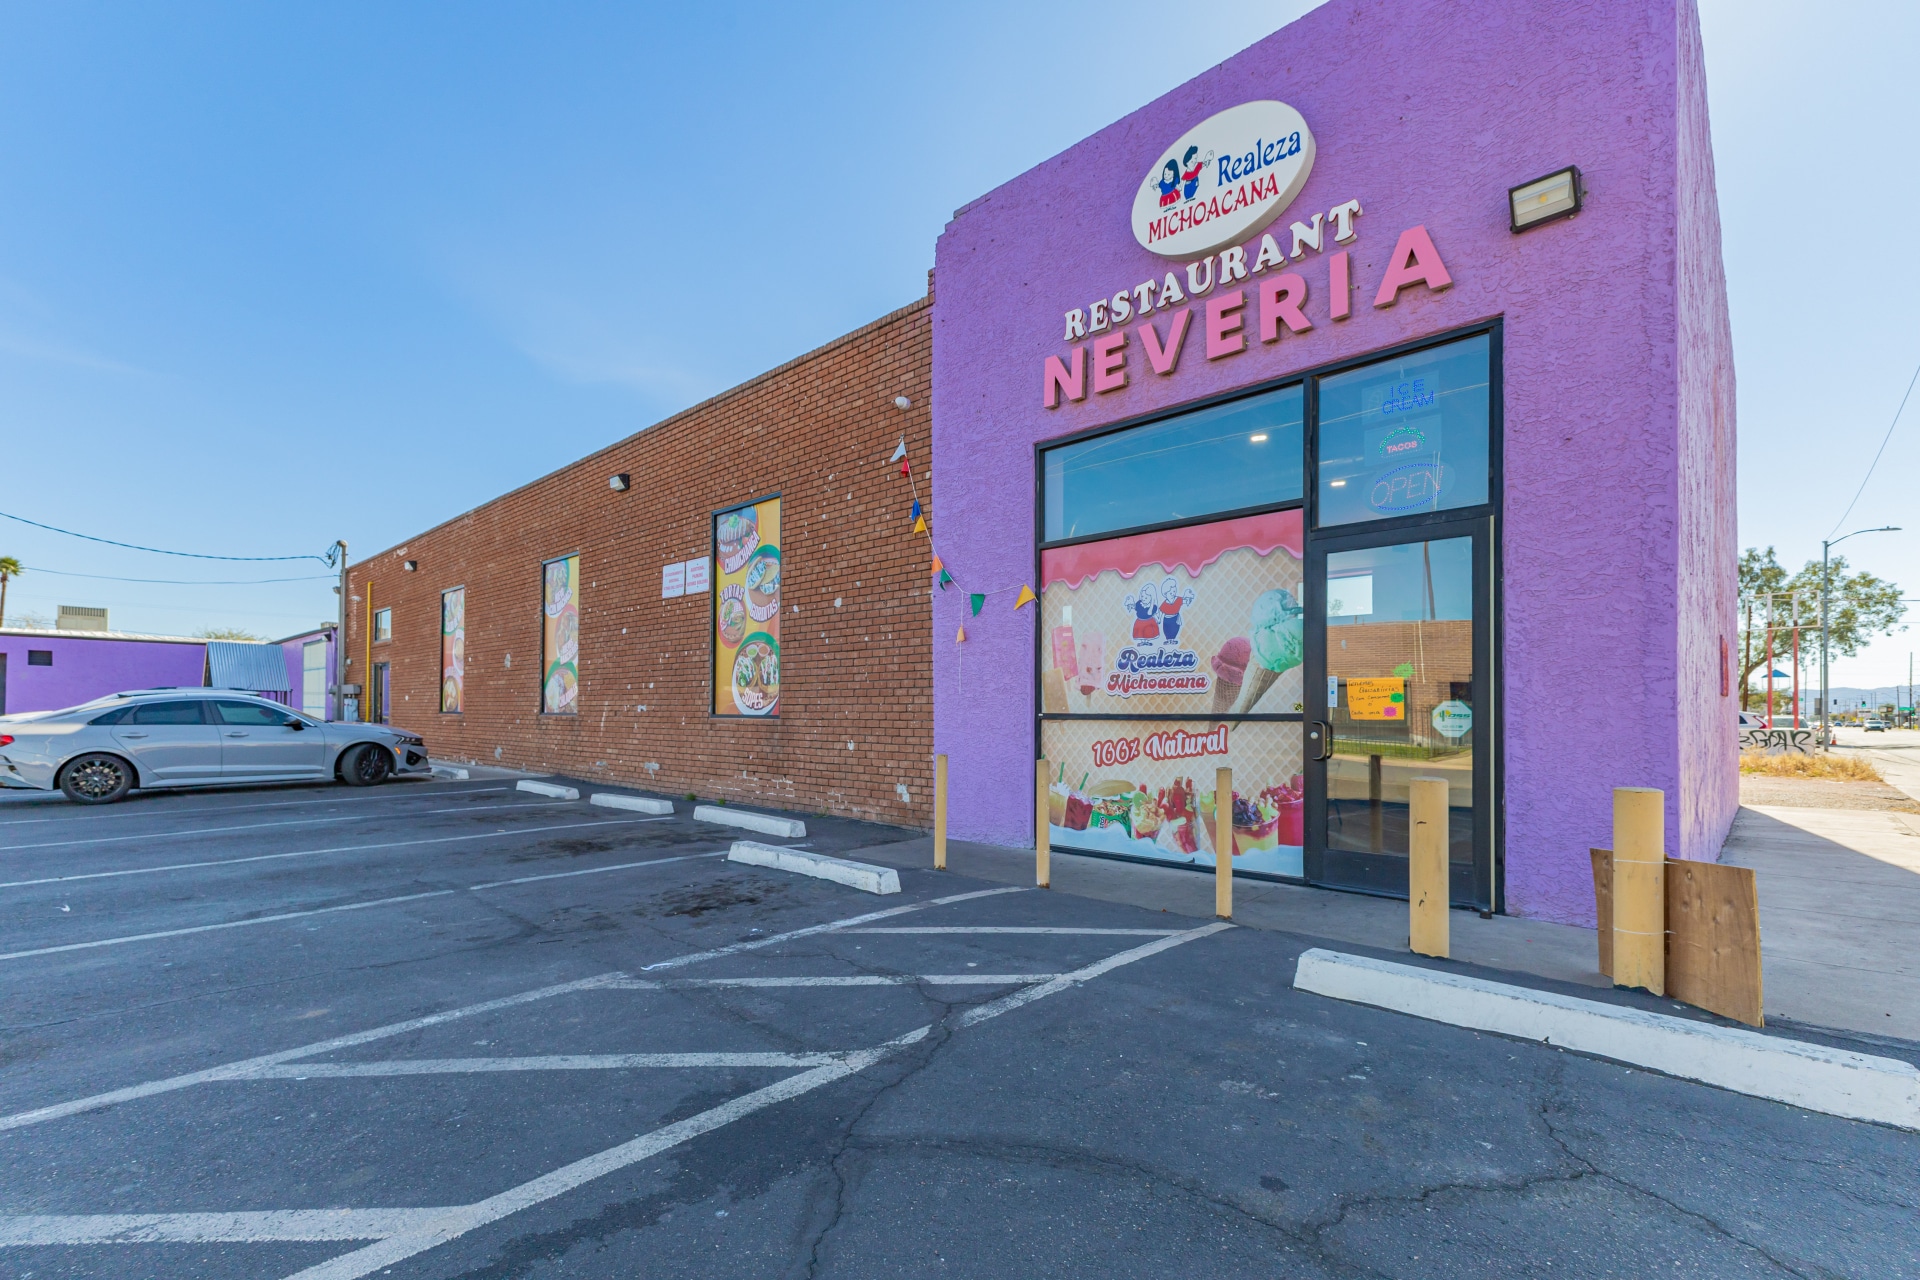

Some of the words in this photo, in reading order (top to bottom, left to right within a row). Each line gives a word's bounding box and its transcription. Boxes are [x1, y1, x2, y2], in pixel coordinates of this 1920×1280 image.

[1217, 131, 1301, 187] Realeza
[1148, 173, 1280, 244] MICHOACANA
[1064, 199, 1364, 342] RESTAURANT
[1043, 224, 1454, 411] NEVERIA
[1389, 378, 1425, 398] ICE
[1382, 389, 1434, 415] CREAM
[1386, 440, 1418, 453] TACOS
[1371, 465, 1444, 506] OPEN
[720, 583, 745, 602] TORTAS
[749, 599, 778, 622] GORDITAS
[1117, 649, 1196, 673] Realeza
[1107, 673, 1208, 693] Michoacana
[742, 687, 763, 709] SOPES
[1093, 739, 1139, 766] 100%
[1145, 727, 1226, 759] Natural
